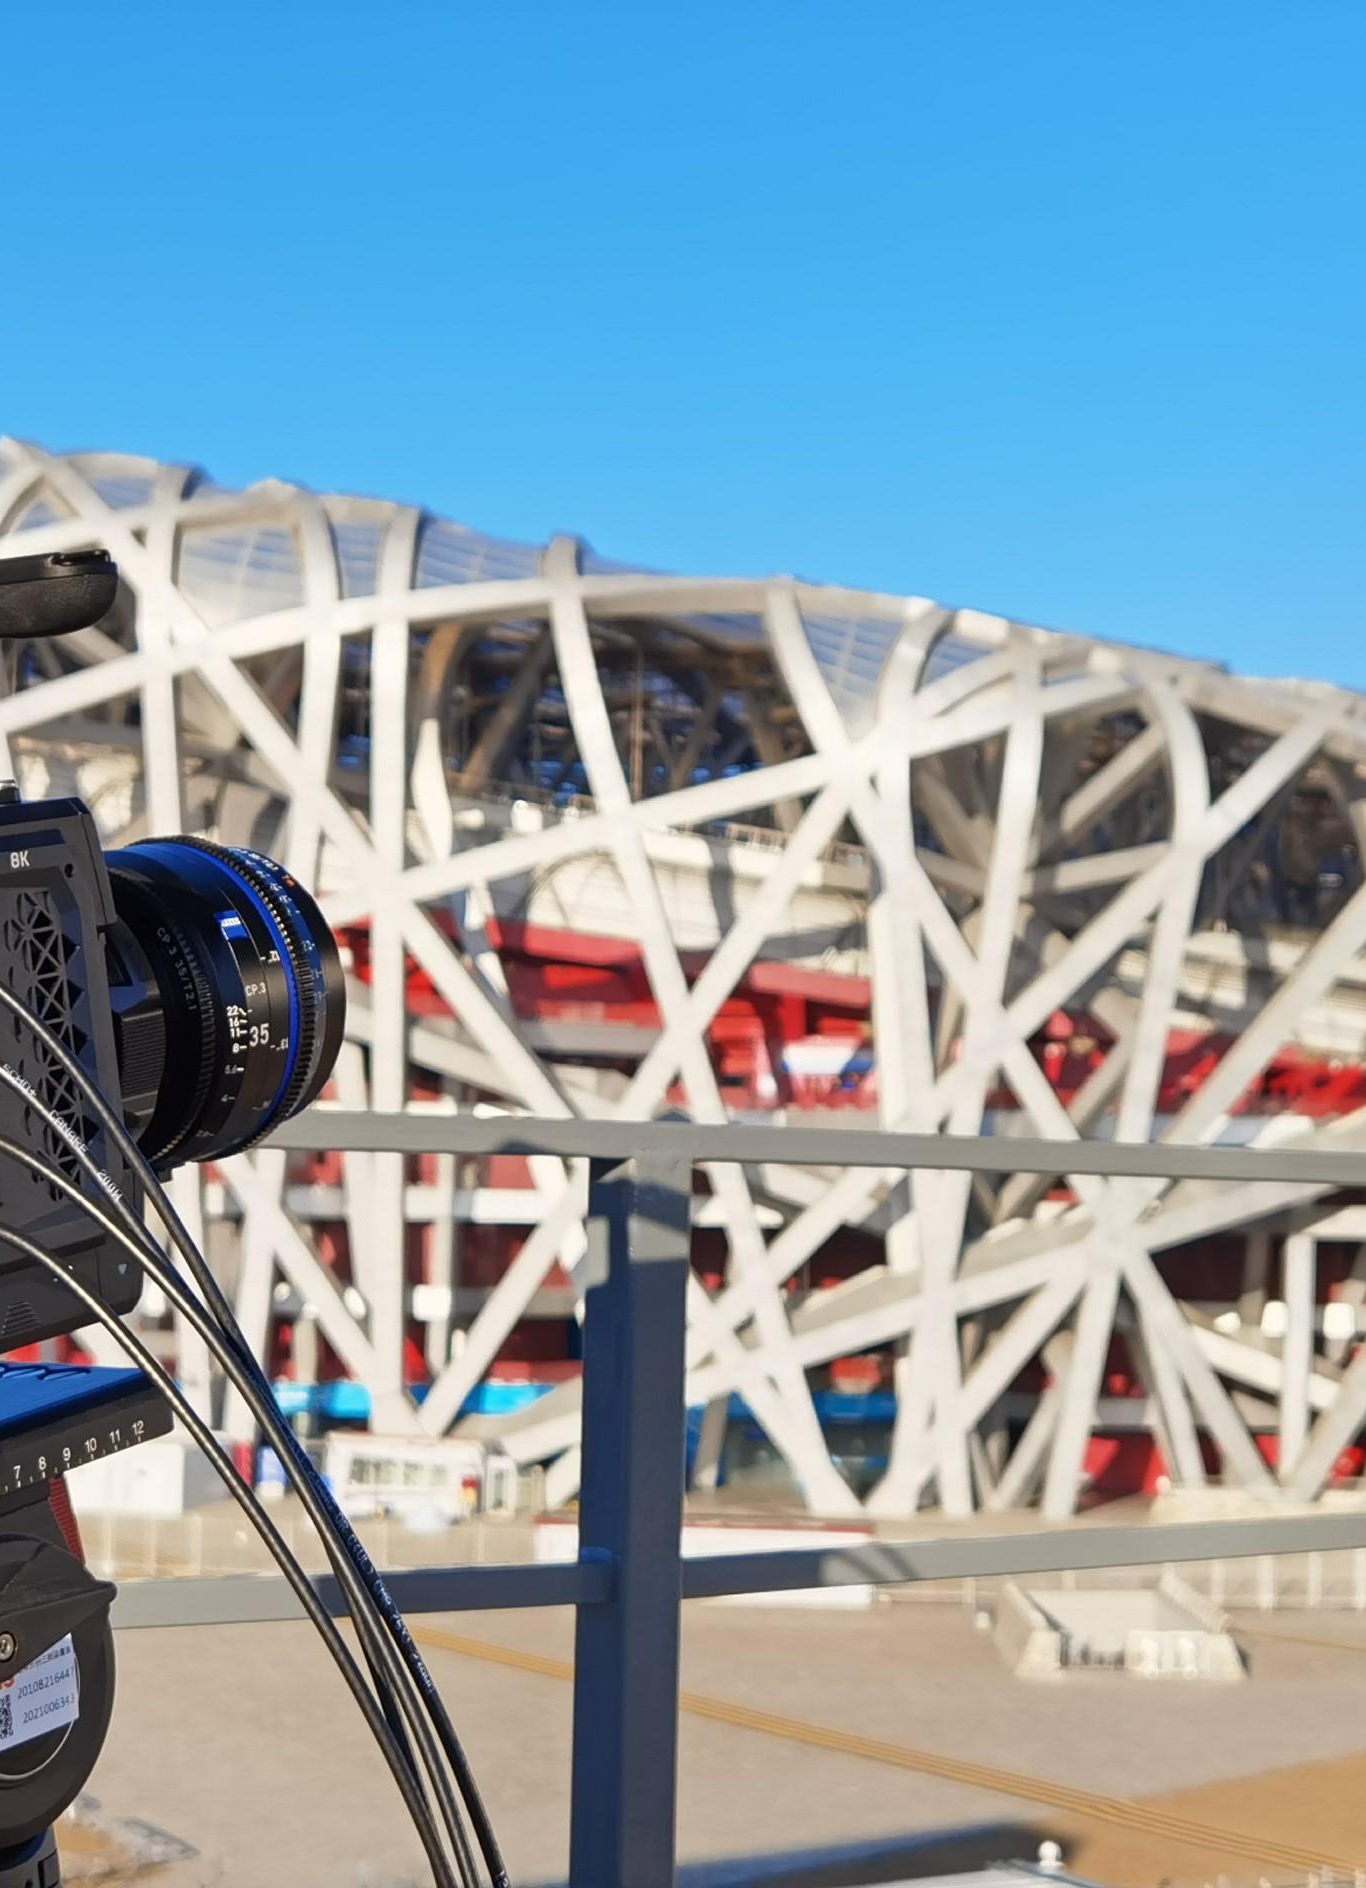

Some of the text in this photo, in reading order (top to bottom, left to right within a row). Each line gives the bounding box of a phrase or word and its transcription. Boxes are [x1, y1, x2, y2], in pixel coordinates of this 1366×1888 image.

[10, 850, 30, 869] 8K
[245, 982, 267, 997] CP.3
[226, 1005, 239, 1017] 22
[228, 1016, 240, 1028] 16
[229, 1027, 241, 1039] 11
[249, 1022, 269, 1047] 35
[49, 1109, 88, 1153] CANARE
[13, 1465, 21, 1480] 7
[38, 1456, 47, 1470] 8
[62, 1447, 72, 1462] 9
[85, 1437, 97, 1453] 10
[109, 1429, 121, 1444] 11
[132, 1420, 145, 1435] 12
